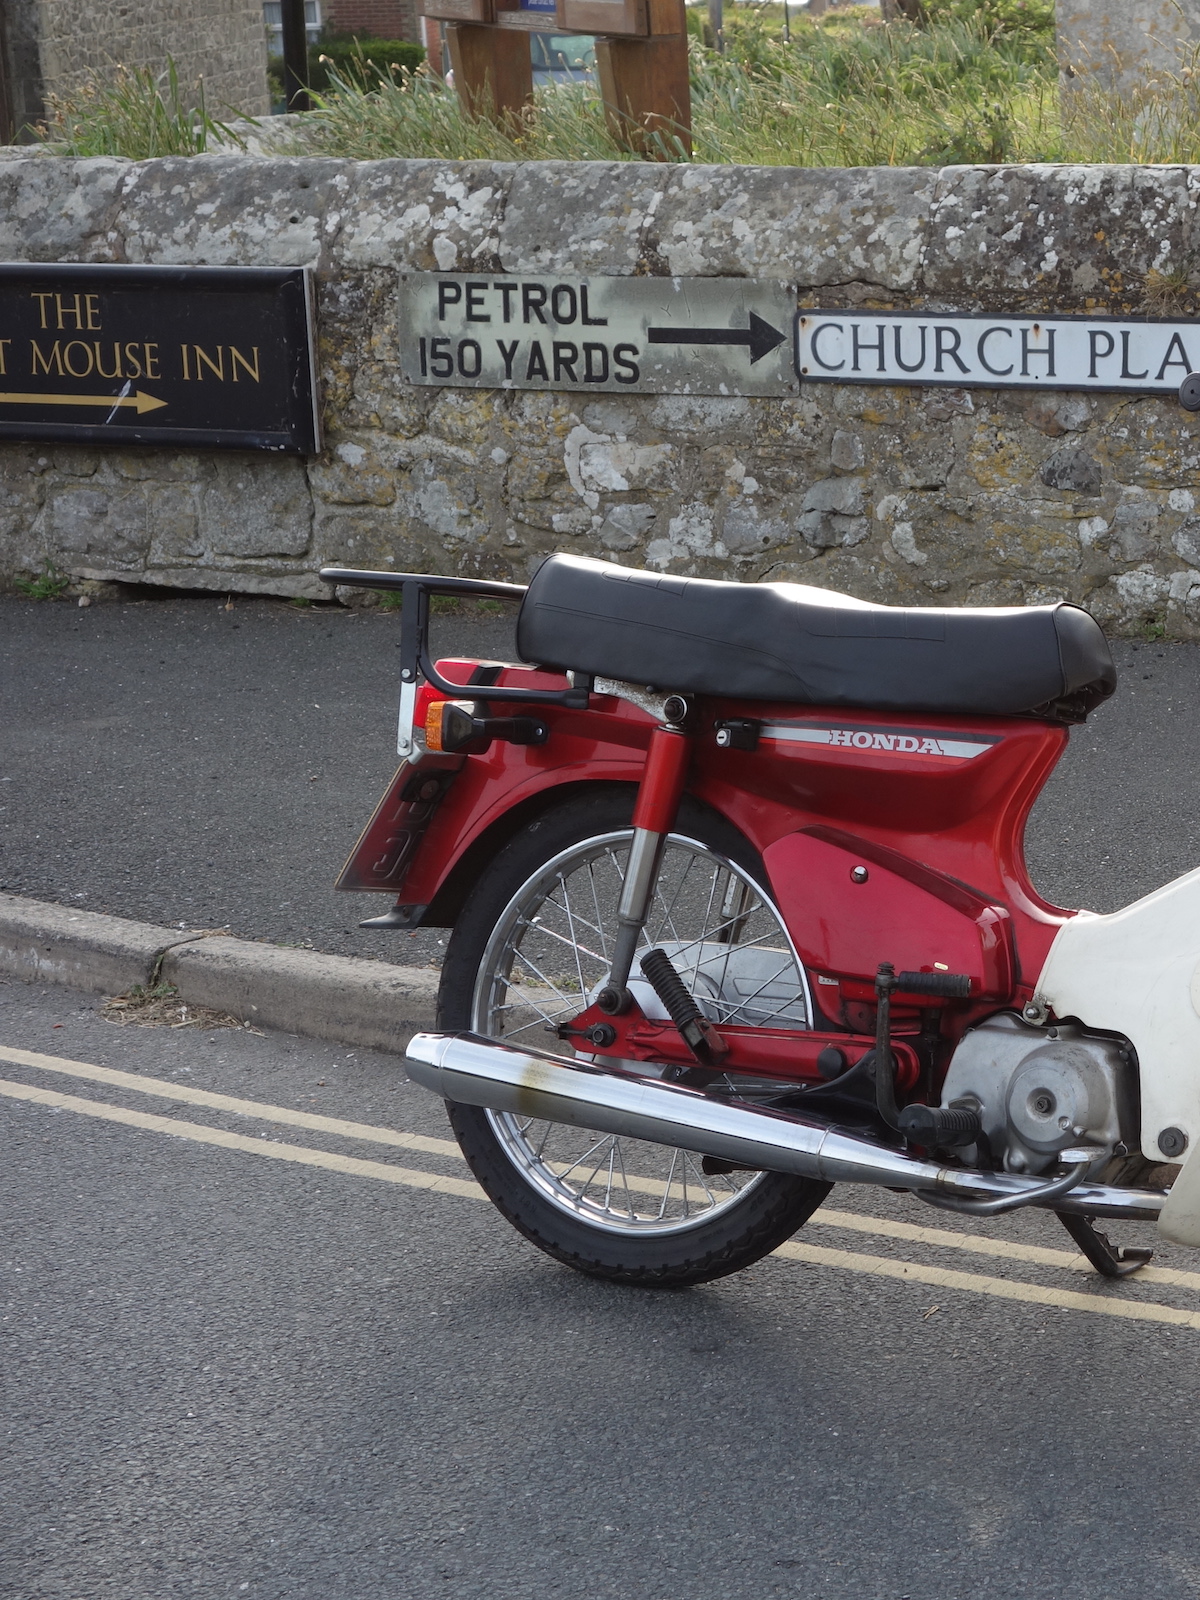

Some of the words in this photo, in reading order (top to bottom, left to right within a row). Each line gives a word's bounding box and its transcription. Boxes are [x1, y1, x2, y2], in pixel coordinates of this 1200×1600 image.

[30, 292, 102, 331] THE
[438, 280, 609, 327] PETROL
[30, 338, 162, 381] MOUSE
[179, 343, 261, 384] INN
[418, 336, 482, 378] 150
[495, 338, 641, 385] YARDS
[810, 322, 1058, 377] CHURCH
[829, 729, 944, 755] HONDA
